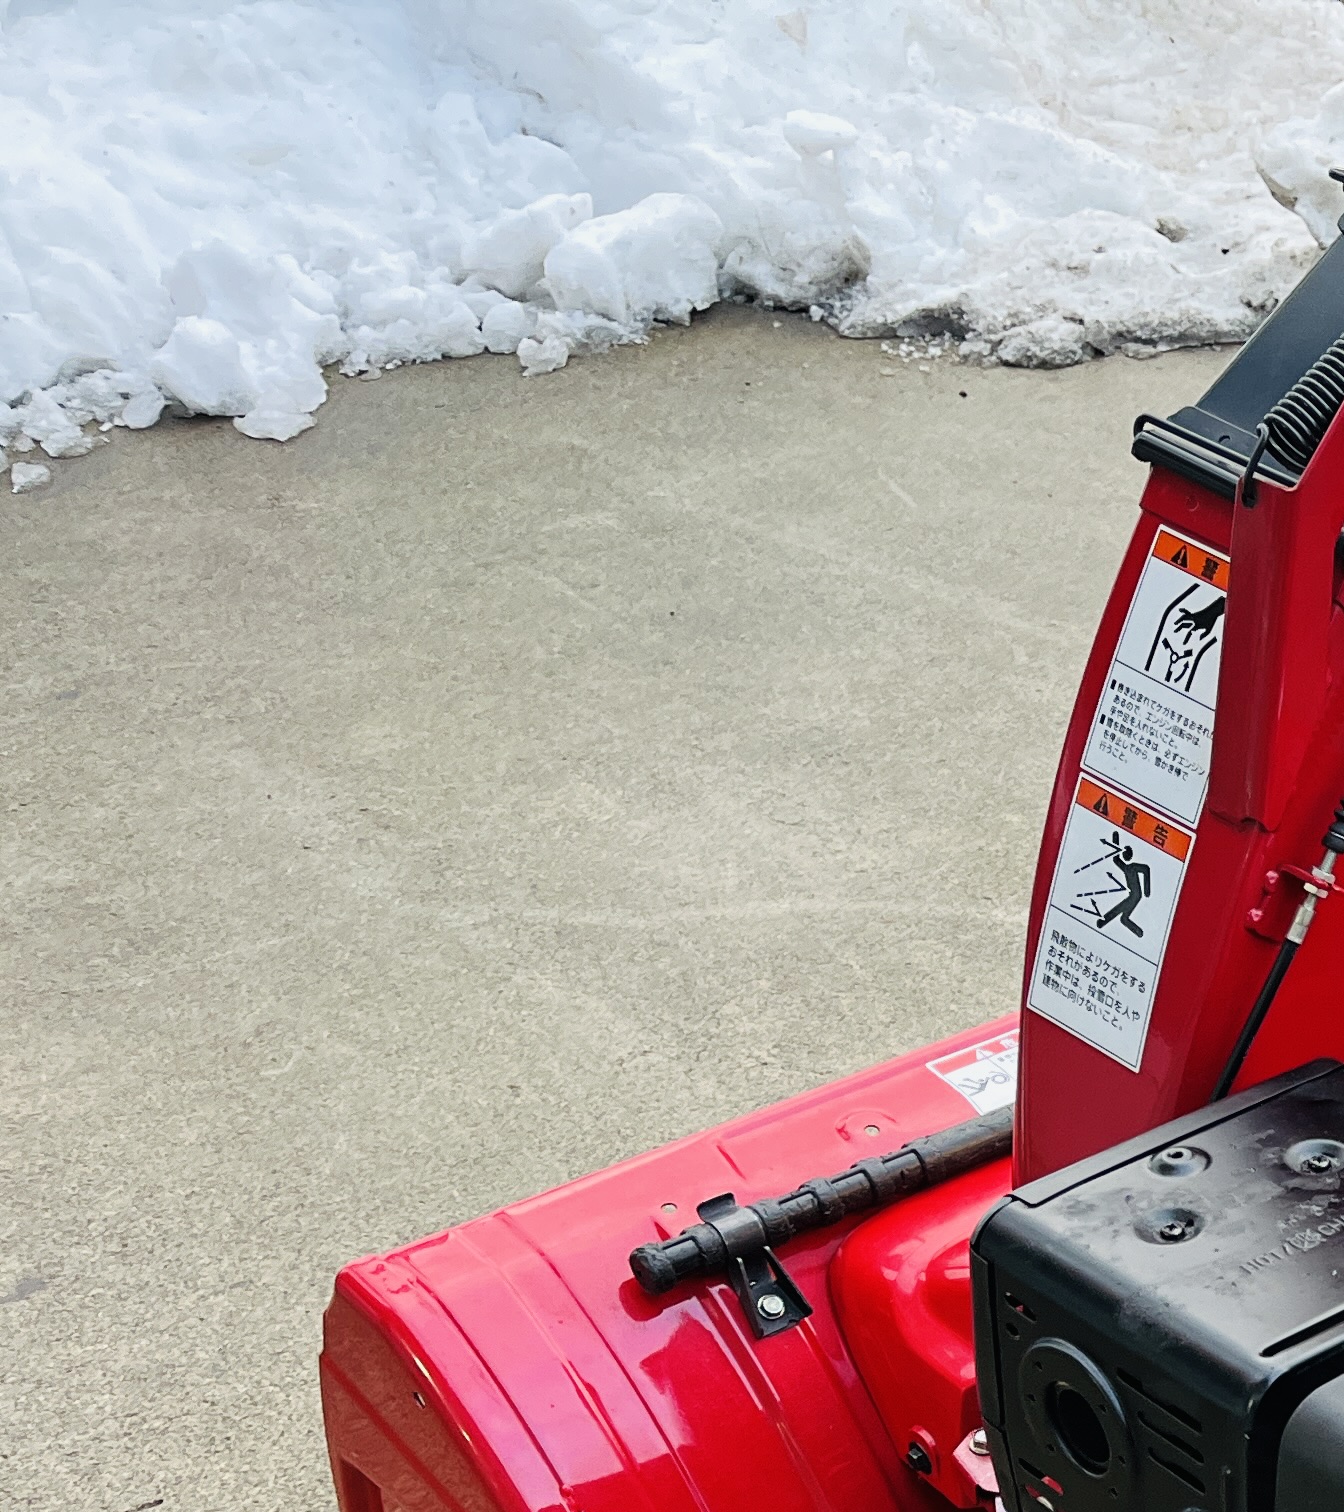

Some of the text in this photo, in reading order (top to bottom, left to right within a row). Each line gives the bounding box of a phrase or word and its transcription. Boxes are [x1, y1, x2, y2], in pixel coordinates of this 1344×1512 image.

[1099, 740, 1128, 764] 行うこと。
[1122, 807, 1169, 848] 警告
[1048, 946, 1120, 996] おそれがあるので、
[1051, 930, 1146, 993] 飛散物によりケガをする
[1042, 973, 1124, 1031] 建物に向けないこと。
[1045, 960, 1141, 1021] 作業中は、投雪口を人や
